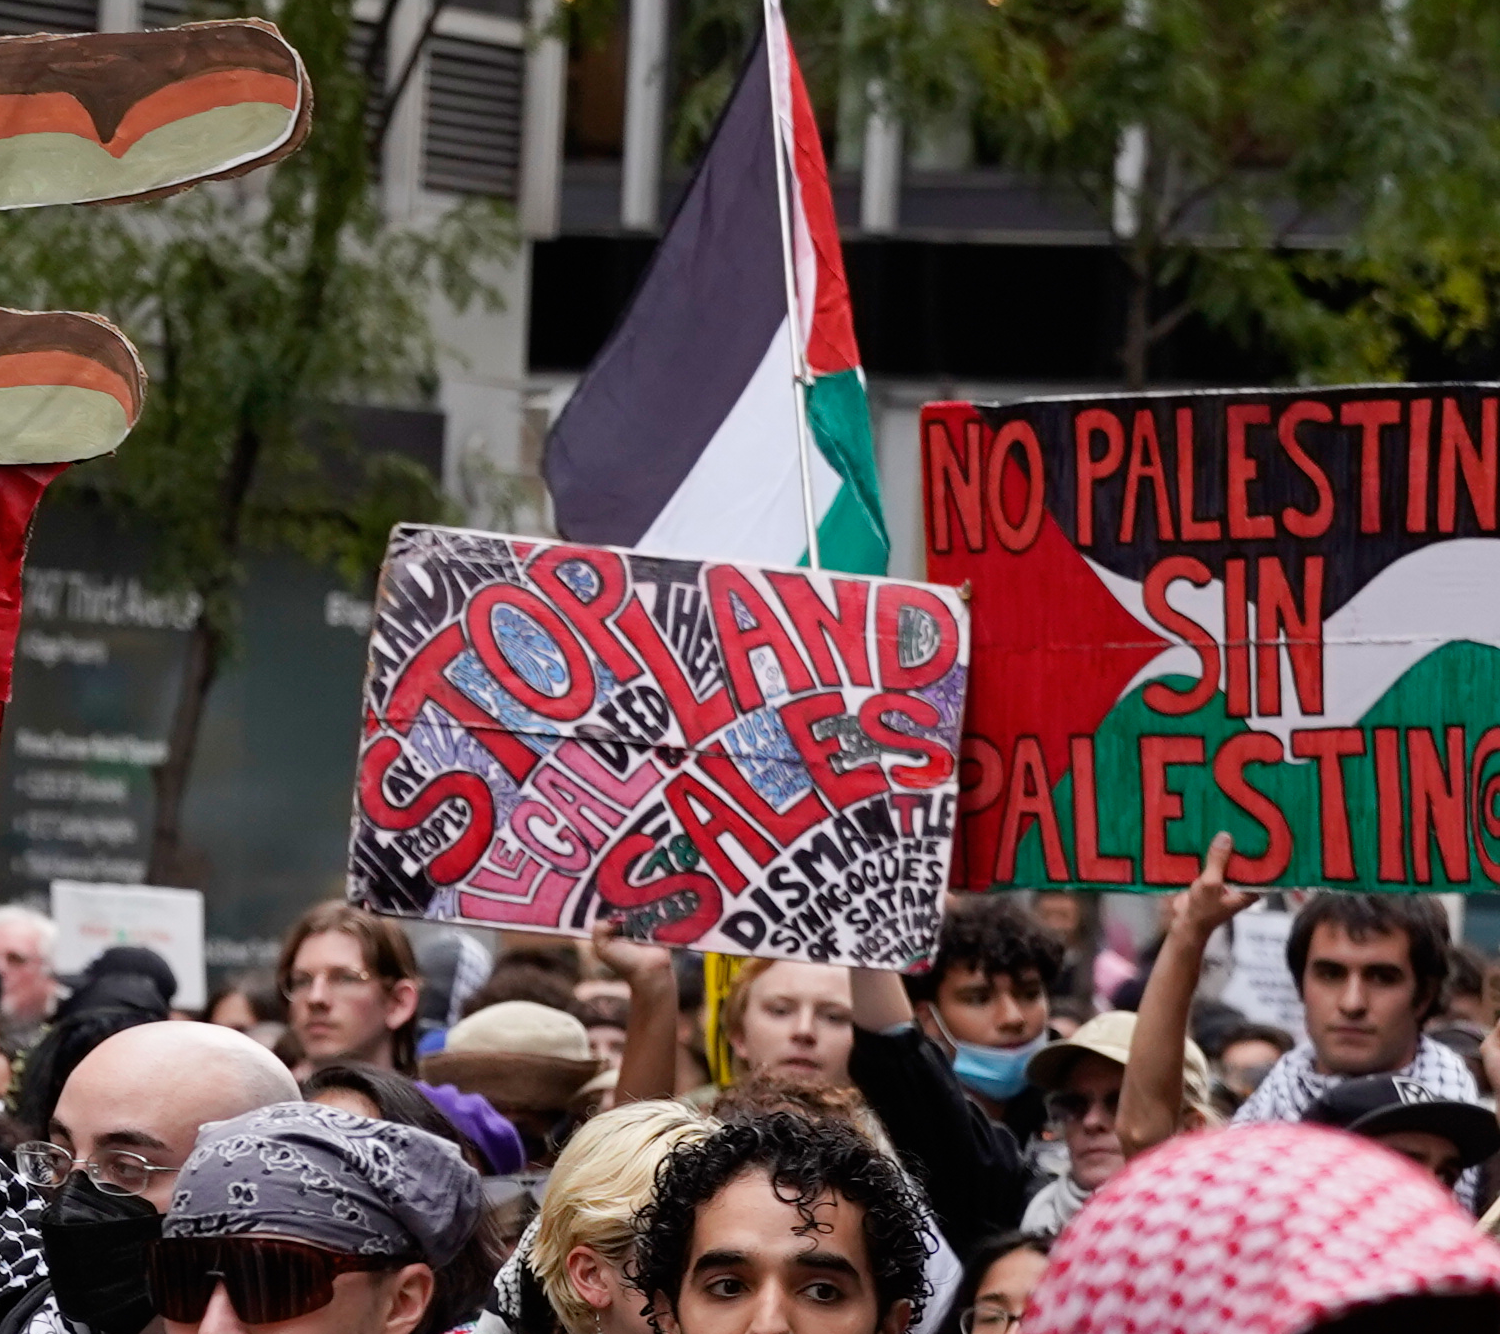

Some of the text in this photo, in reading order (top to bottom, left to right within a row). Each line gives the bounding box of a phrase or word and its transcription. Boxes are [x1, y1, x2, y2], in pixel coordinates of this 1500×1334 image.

[927, 418, 1045, 553] NO
[616, 563, 961, 746] LAND
[1140, 552, 1326, 720] SIN
[360, 545, 642, 888] STOP
[574, 685, 670, 774] DEED
[595, 691, 955, 946] SALES
[719, 792, 957, 951] DISMANTLE
[770, 848, 943, 955] SYNAGOGUES
[806, 885, 939, 963] OF SATAN
